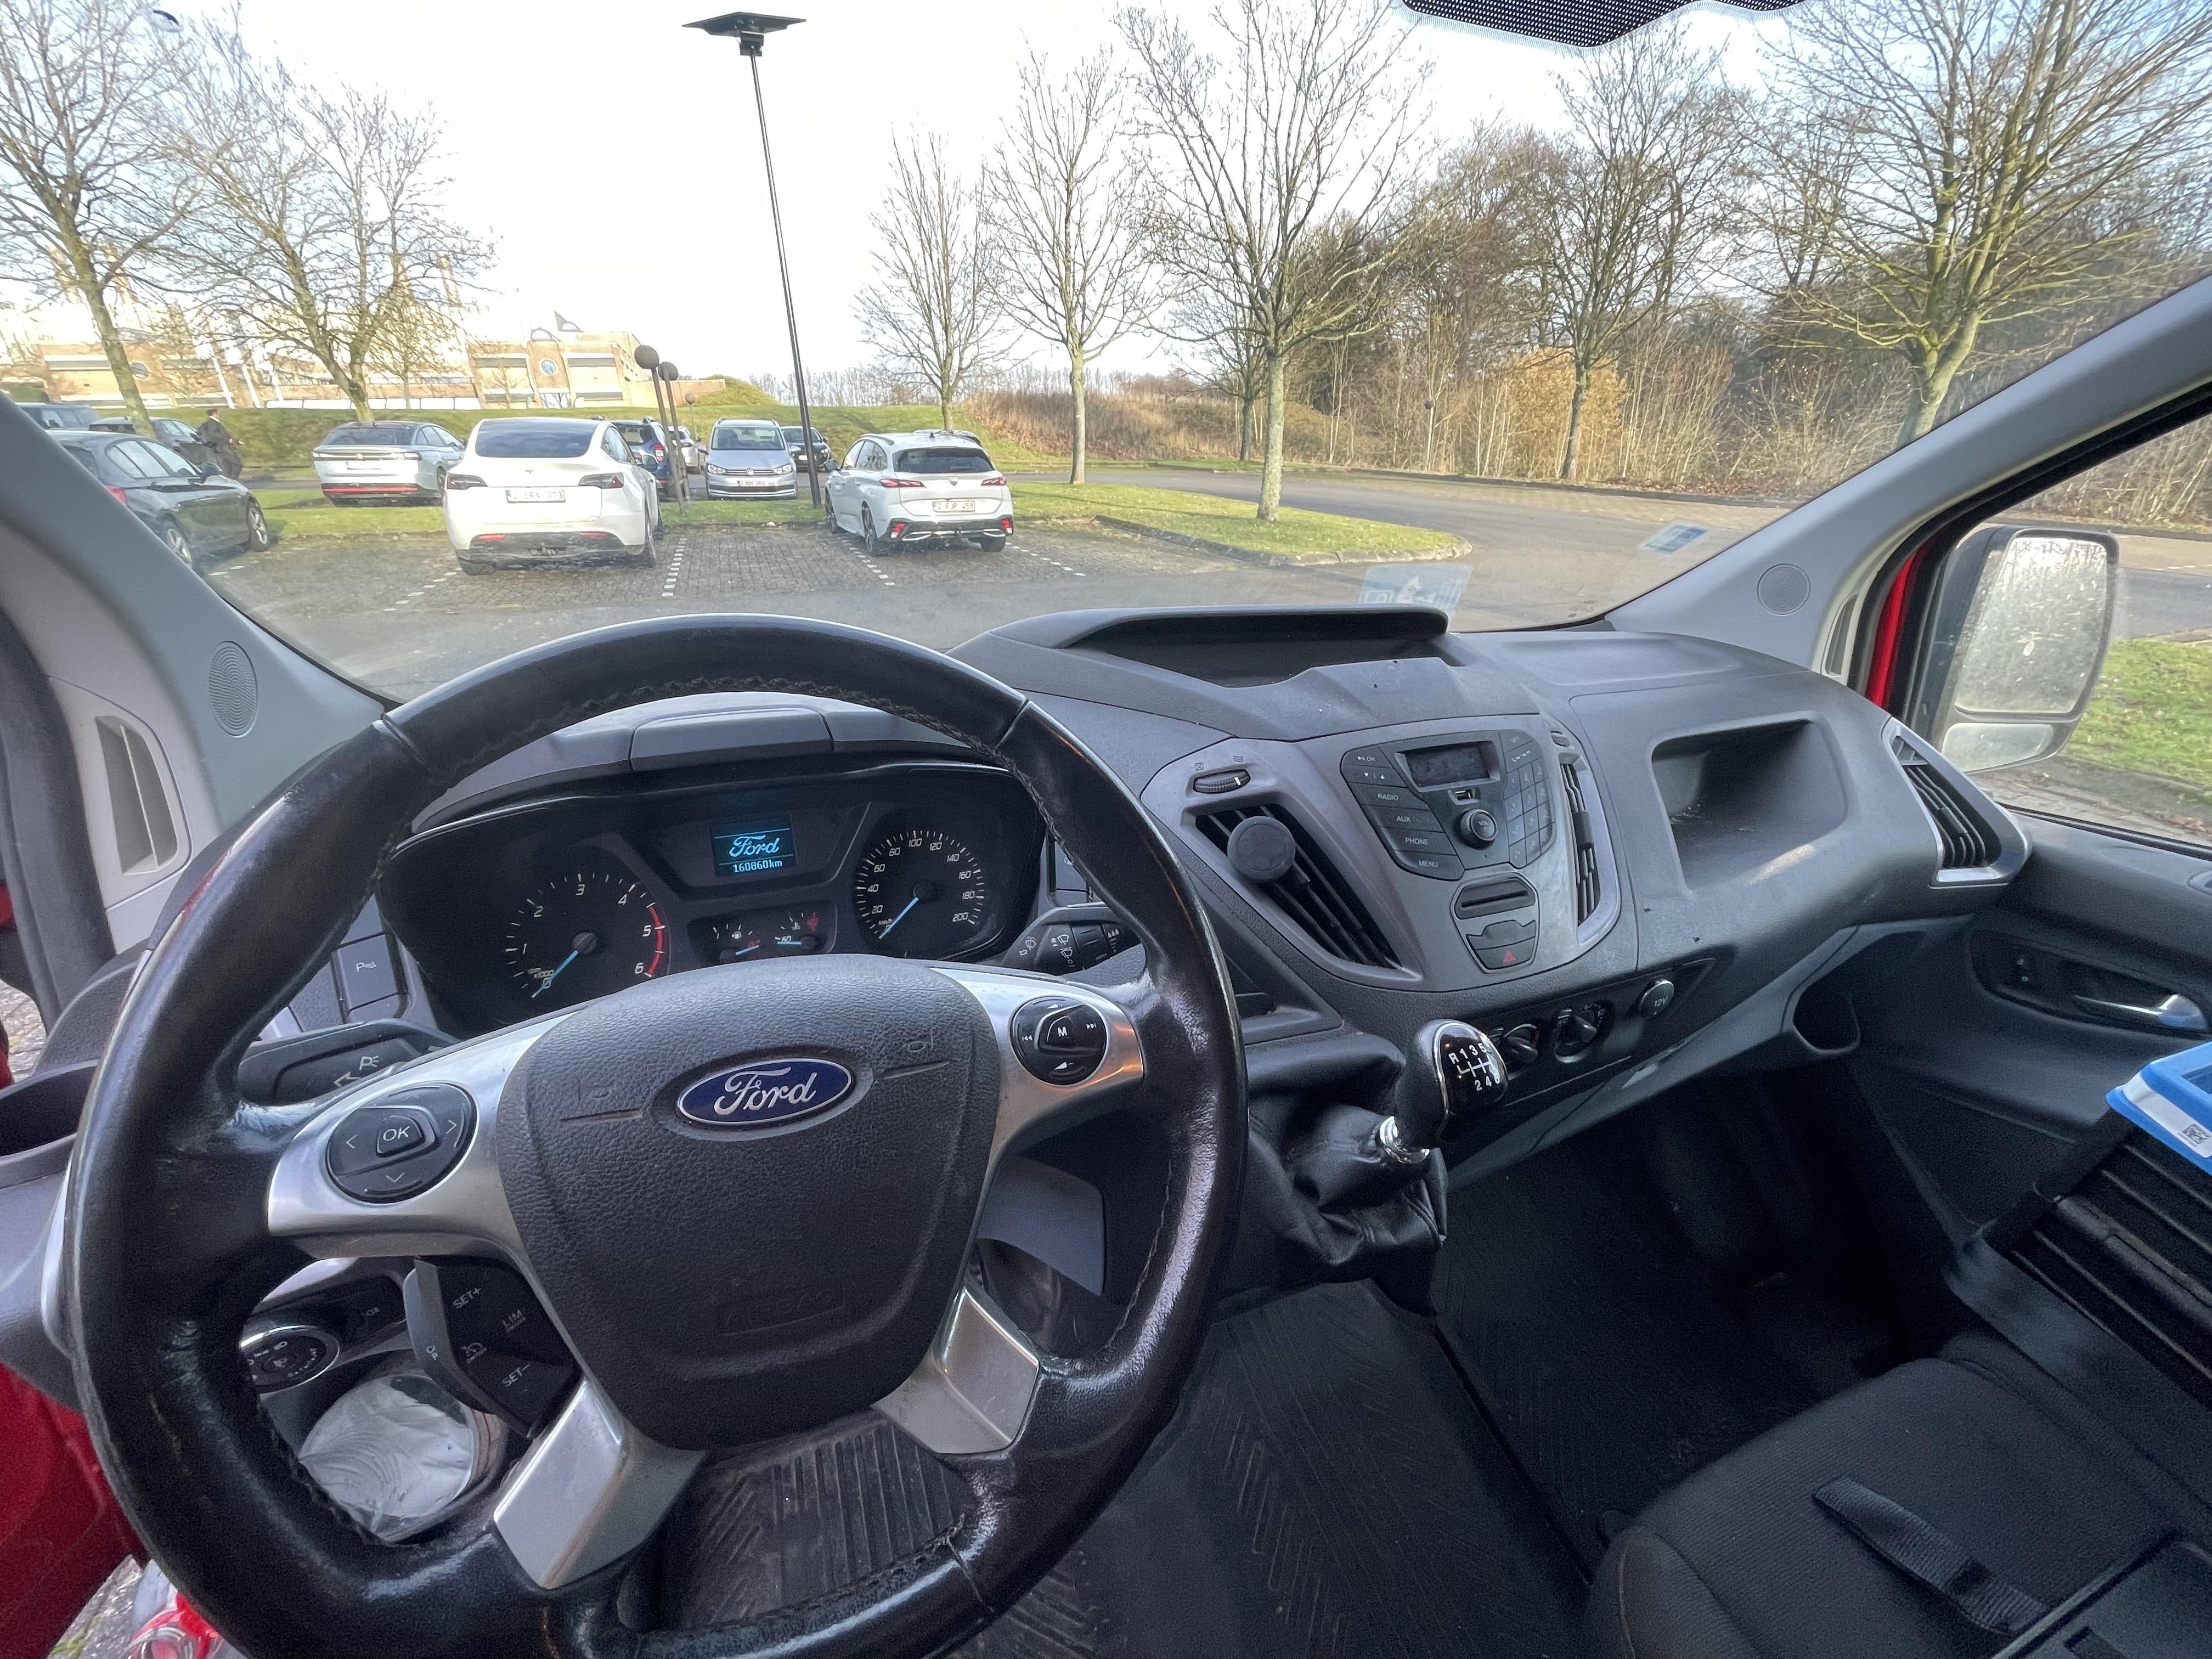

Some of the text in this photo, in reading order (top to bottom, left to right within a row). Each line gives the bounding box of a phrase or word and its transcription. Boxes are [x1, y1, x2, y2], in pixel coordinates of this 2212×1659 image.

[548, 491, 563, 499] 373
[729, 834, 780, 857] Ford
[909, 838, 922, 847] 100
[1405, 837, 1429, 845] PHONE
[889, 847, 901, 856] 80
[929, 842, 943, 851] 120
[947, 853, 960, 862] 140
[873, 864, 885, 873] 60
[1418, 860, 1438, 868] MENU
[958, 871, 972, 879] 160
[576, 884, 585, 896] 3
[867, 884, 879, 893] 40
[618, 894, 627, 906] 4
[962, 890, 975, 900] 180
[534, 906, 544, 918] 2
[871, 905, 883, 914] 20
[952, 912, 969, 922] 200
[642, 925, 651, 938] 5
[522, 943, 527, 955] 1
[635, 962, 644, 974] 6
[1654, 996, 1668, 1007] 12V
[1057, 1028, 1067, 1036] M
[1459, 1048, 1468, 1059] 1
[1469, 1045, 1479, 1056] 3
[1477, 1043, 1487, 1053] 5
[1474, 1079, 1483, 1091] 2
[1486, 1076, 1492, 1086] 4
[714, 1066, 817, 1115] Ford
[383, 1126, 410, 1141] OK
[453, 1288, 481, 1309] SET+
